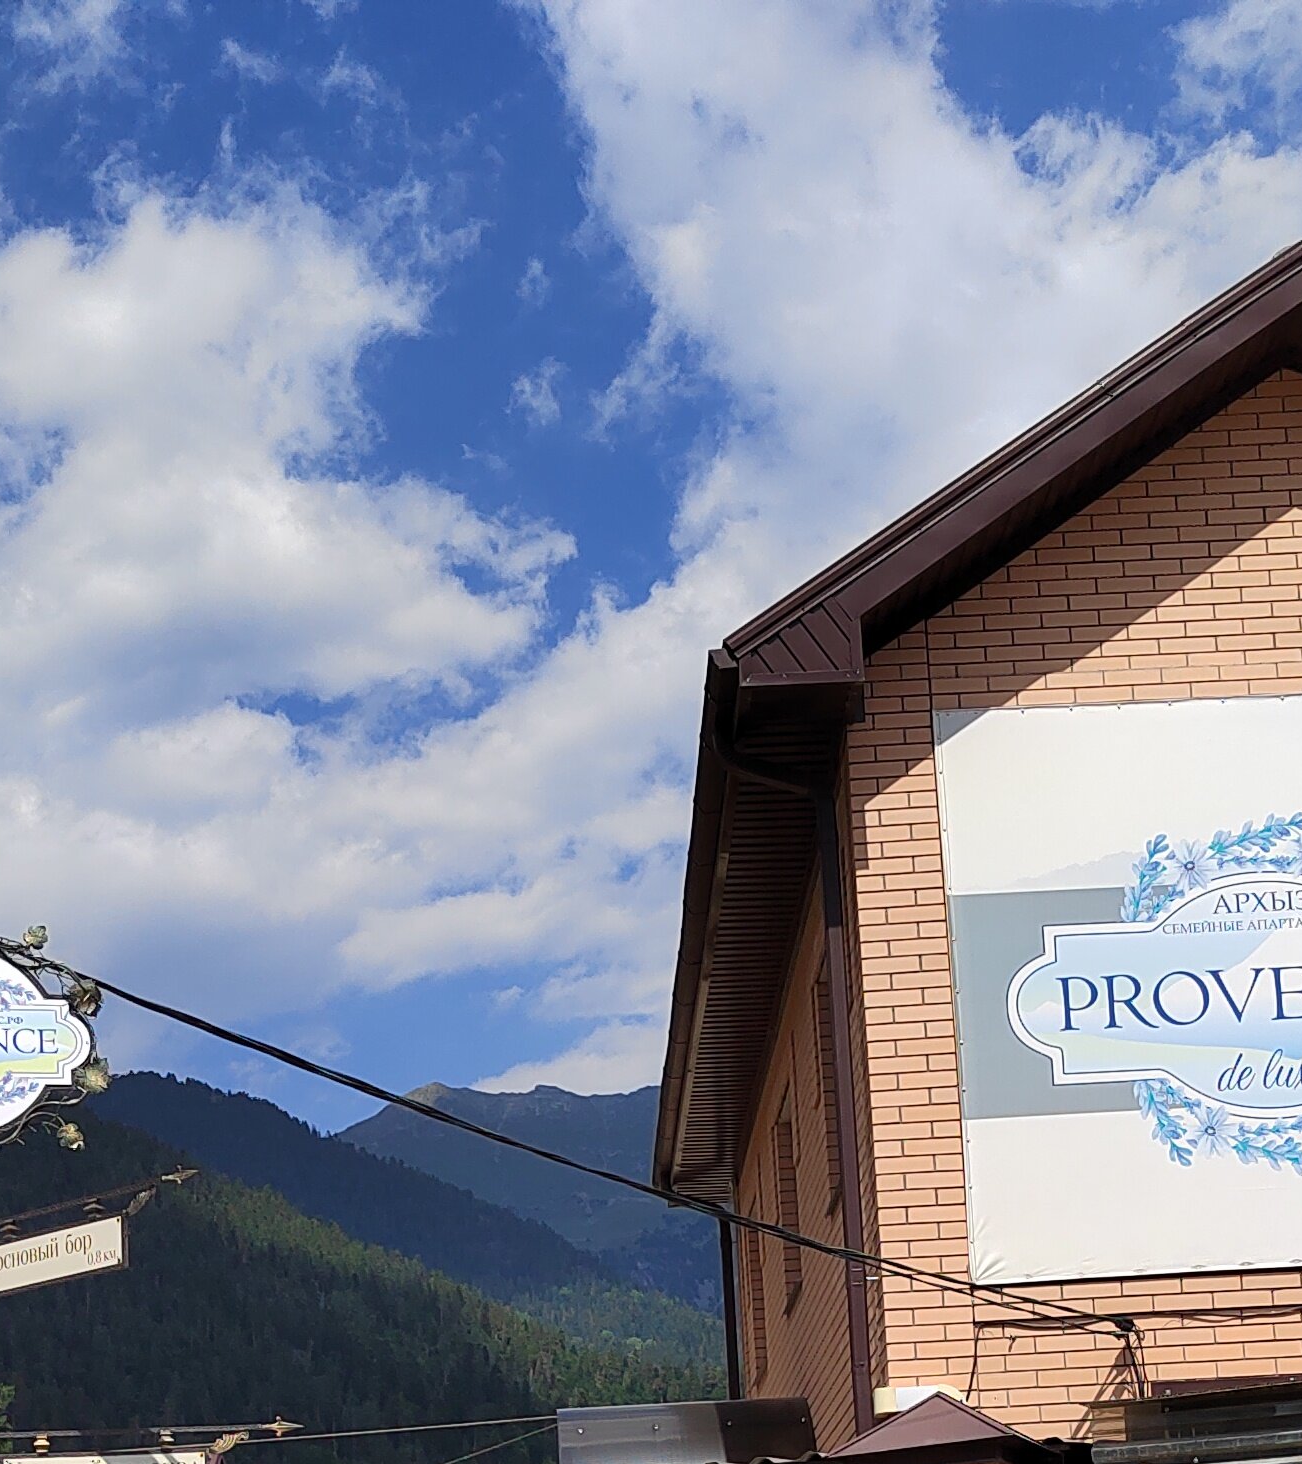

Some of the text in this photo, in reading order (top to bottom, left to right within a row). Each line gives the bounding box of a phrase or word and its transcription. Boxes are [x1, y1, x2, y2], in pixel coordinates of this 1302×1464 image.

[1162, 919, 1244, 936] СЕМЕЙНЫЕ
[1217, 1053, 1256, 1092] de
[65, 1233, 92, 1255] бор
